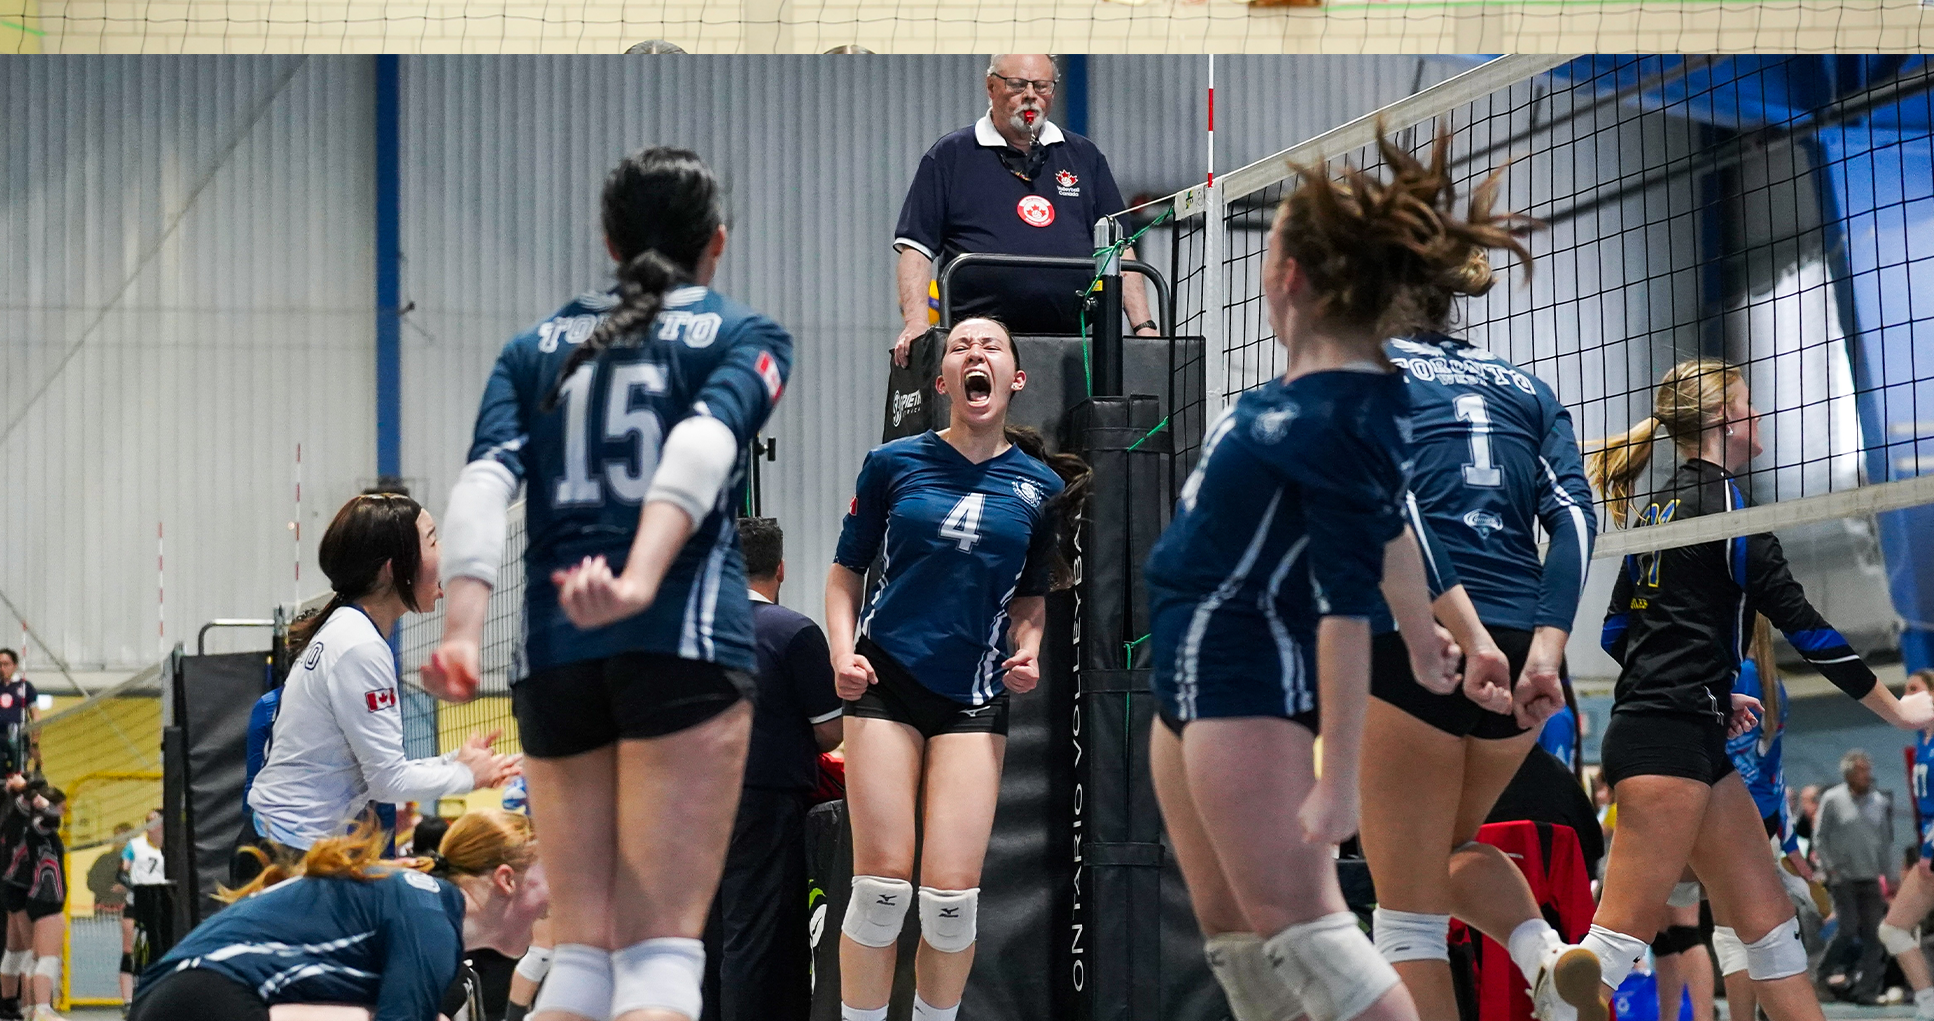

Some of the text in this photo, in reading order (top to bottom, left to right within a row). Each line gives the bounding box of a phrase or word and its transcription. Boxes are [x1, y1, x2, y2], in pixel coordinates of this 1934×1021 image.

[538, 311, 723, 353] TOTO
[554, 361, 671, 506] 15
[1452, 393, 1504, 489] 1
[938, 492, 986, 554] 4
[1071, 507, 1084, 992] ONTARIO VOLLEYBAL
[148, 857, 158, 874] 7
